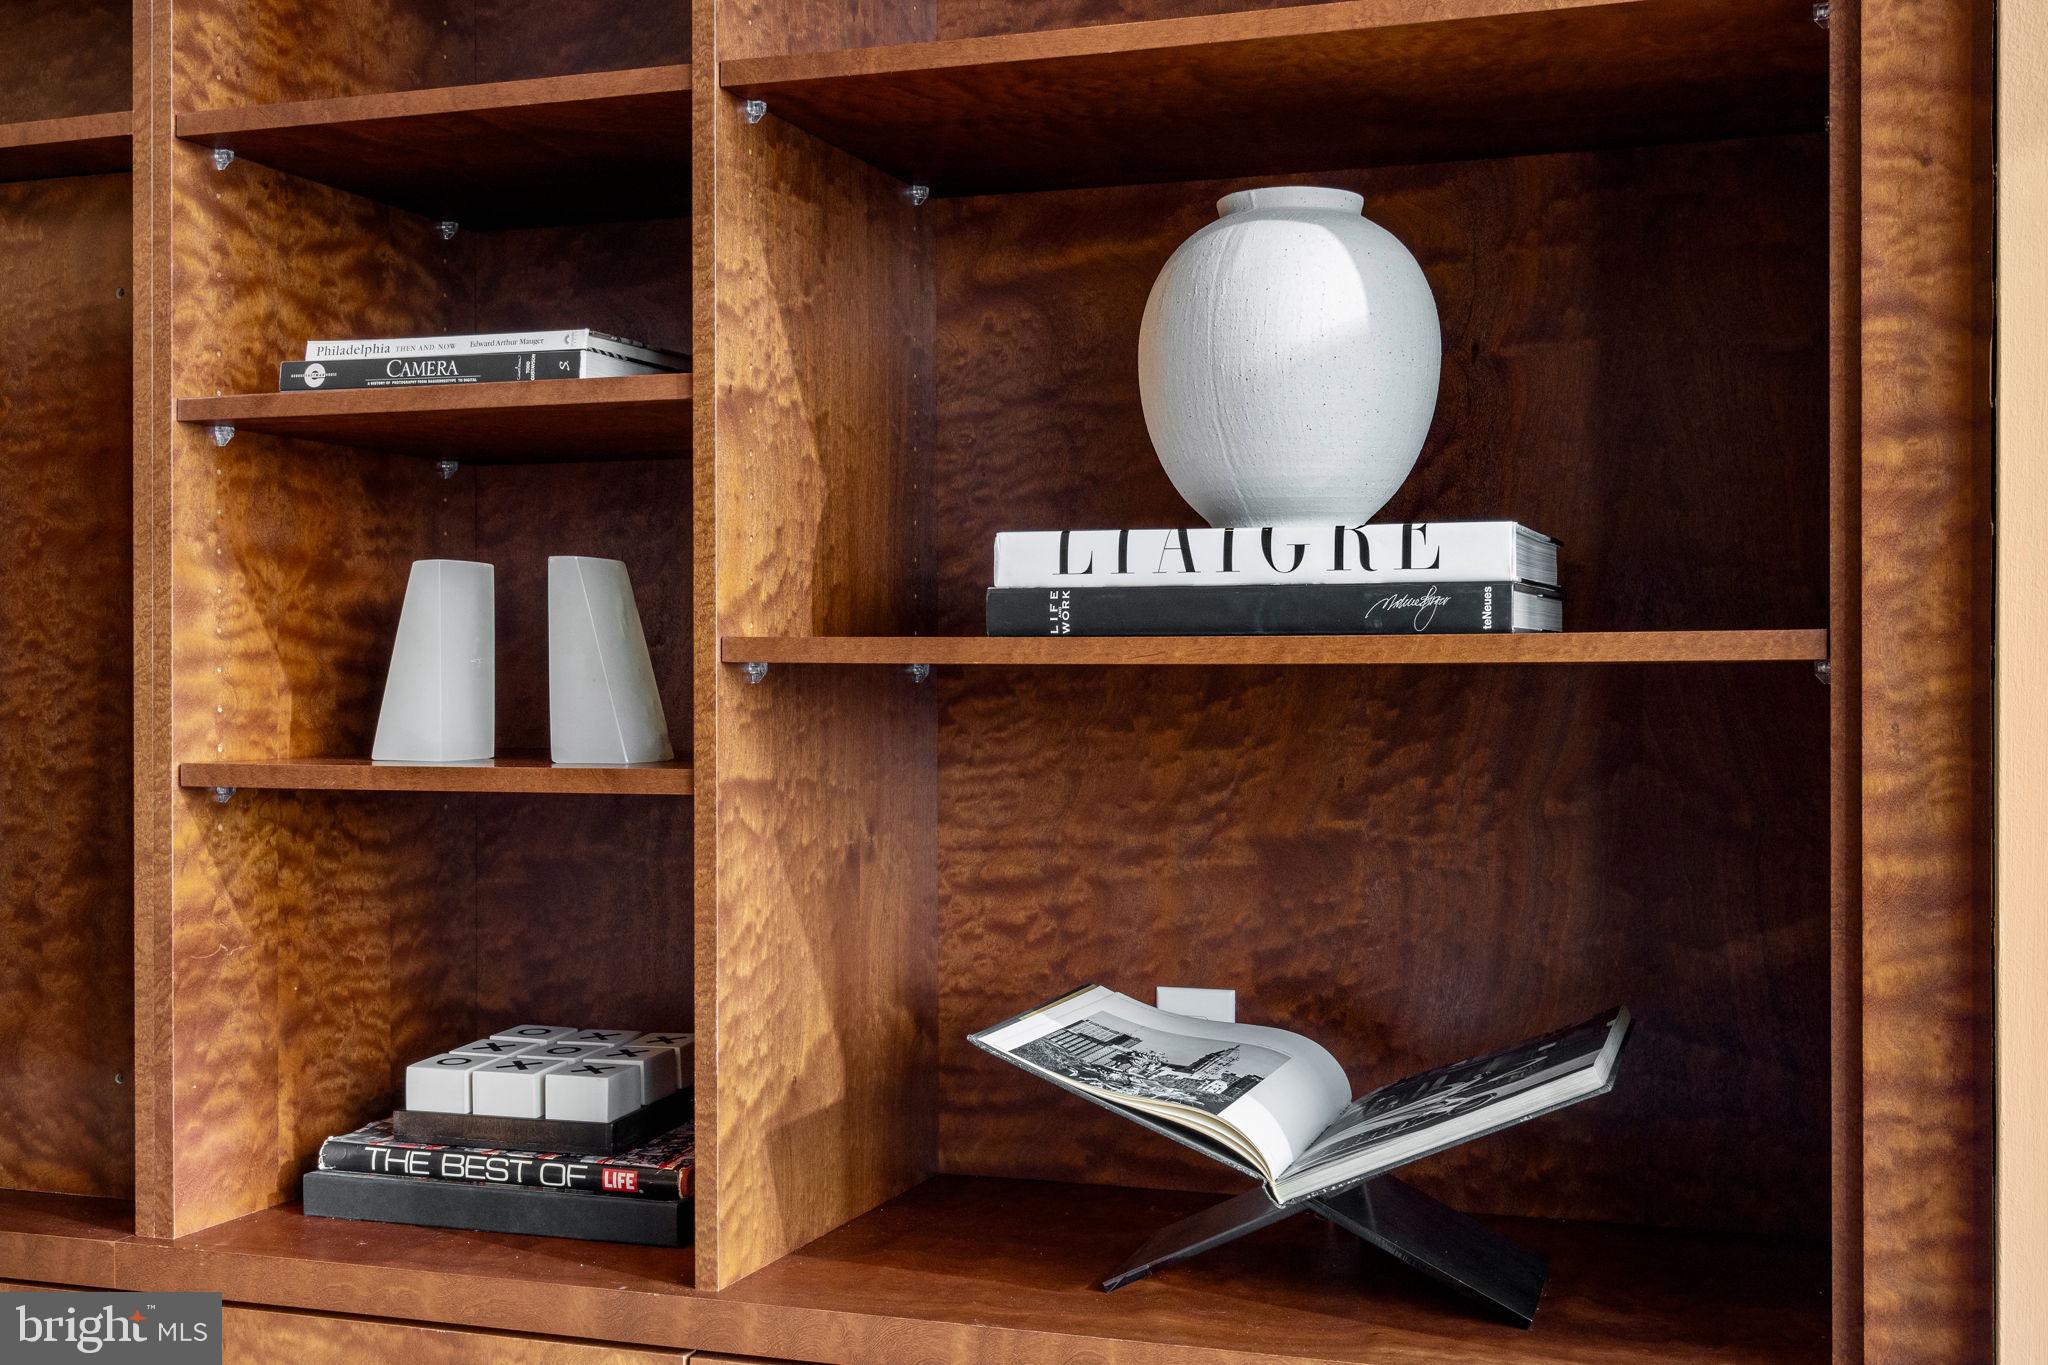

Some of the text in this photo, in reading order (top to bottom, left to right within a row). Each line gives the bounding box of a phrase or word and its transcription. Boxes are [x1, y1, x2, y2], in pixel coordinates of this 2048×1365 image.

[317, 343, 391, 357] Philadelphia
[470, 338, 545, 348] Edward Arthur Mauger
[386, 359, 459, 378] CAMERA
[1050, 590, 1059, 634] LIFE
[1062, 590, 1070, 634] WORK
[1482, 586, 1493, 630] teNeues
[365, 1146, 635, 1190] THE BEST OF LIFE
